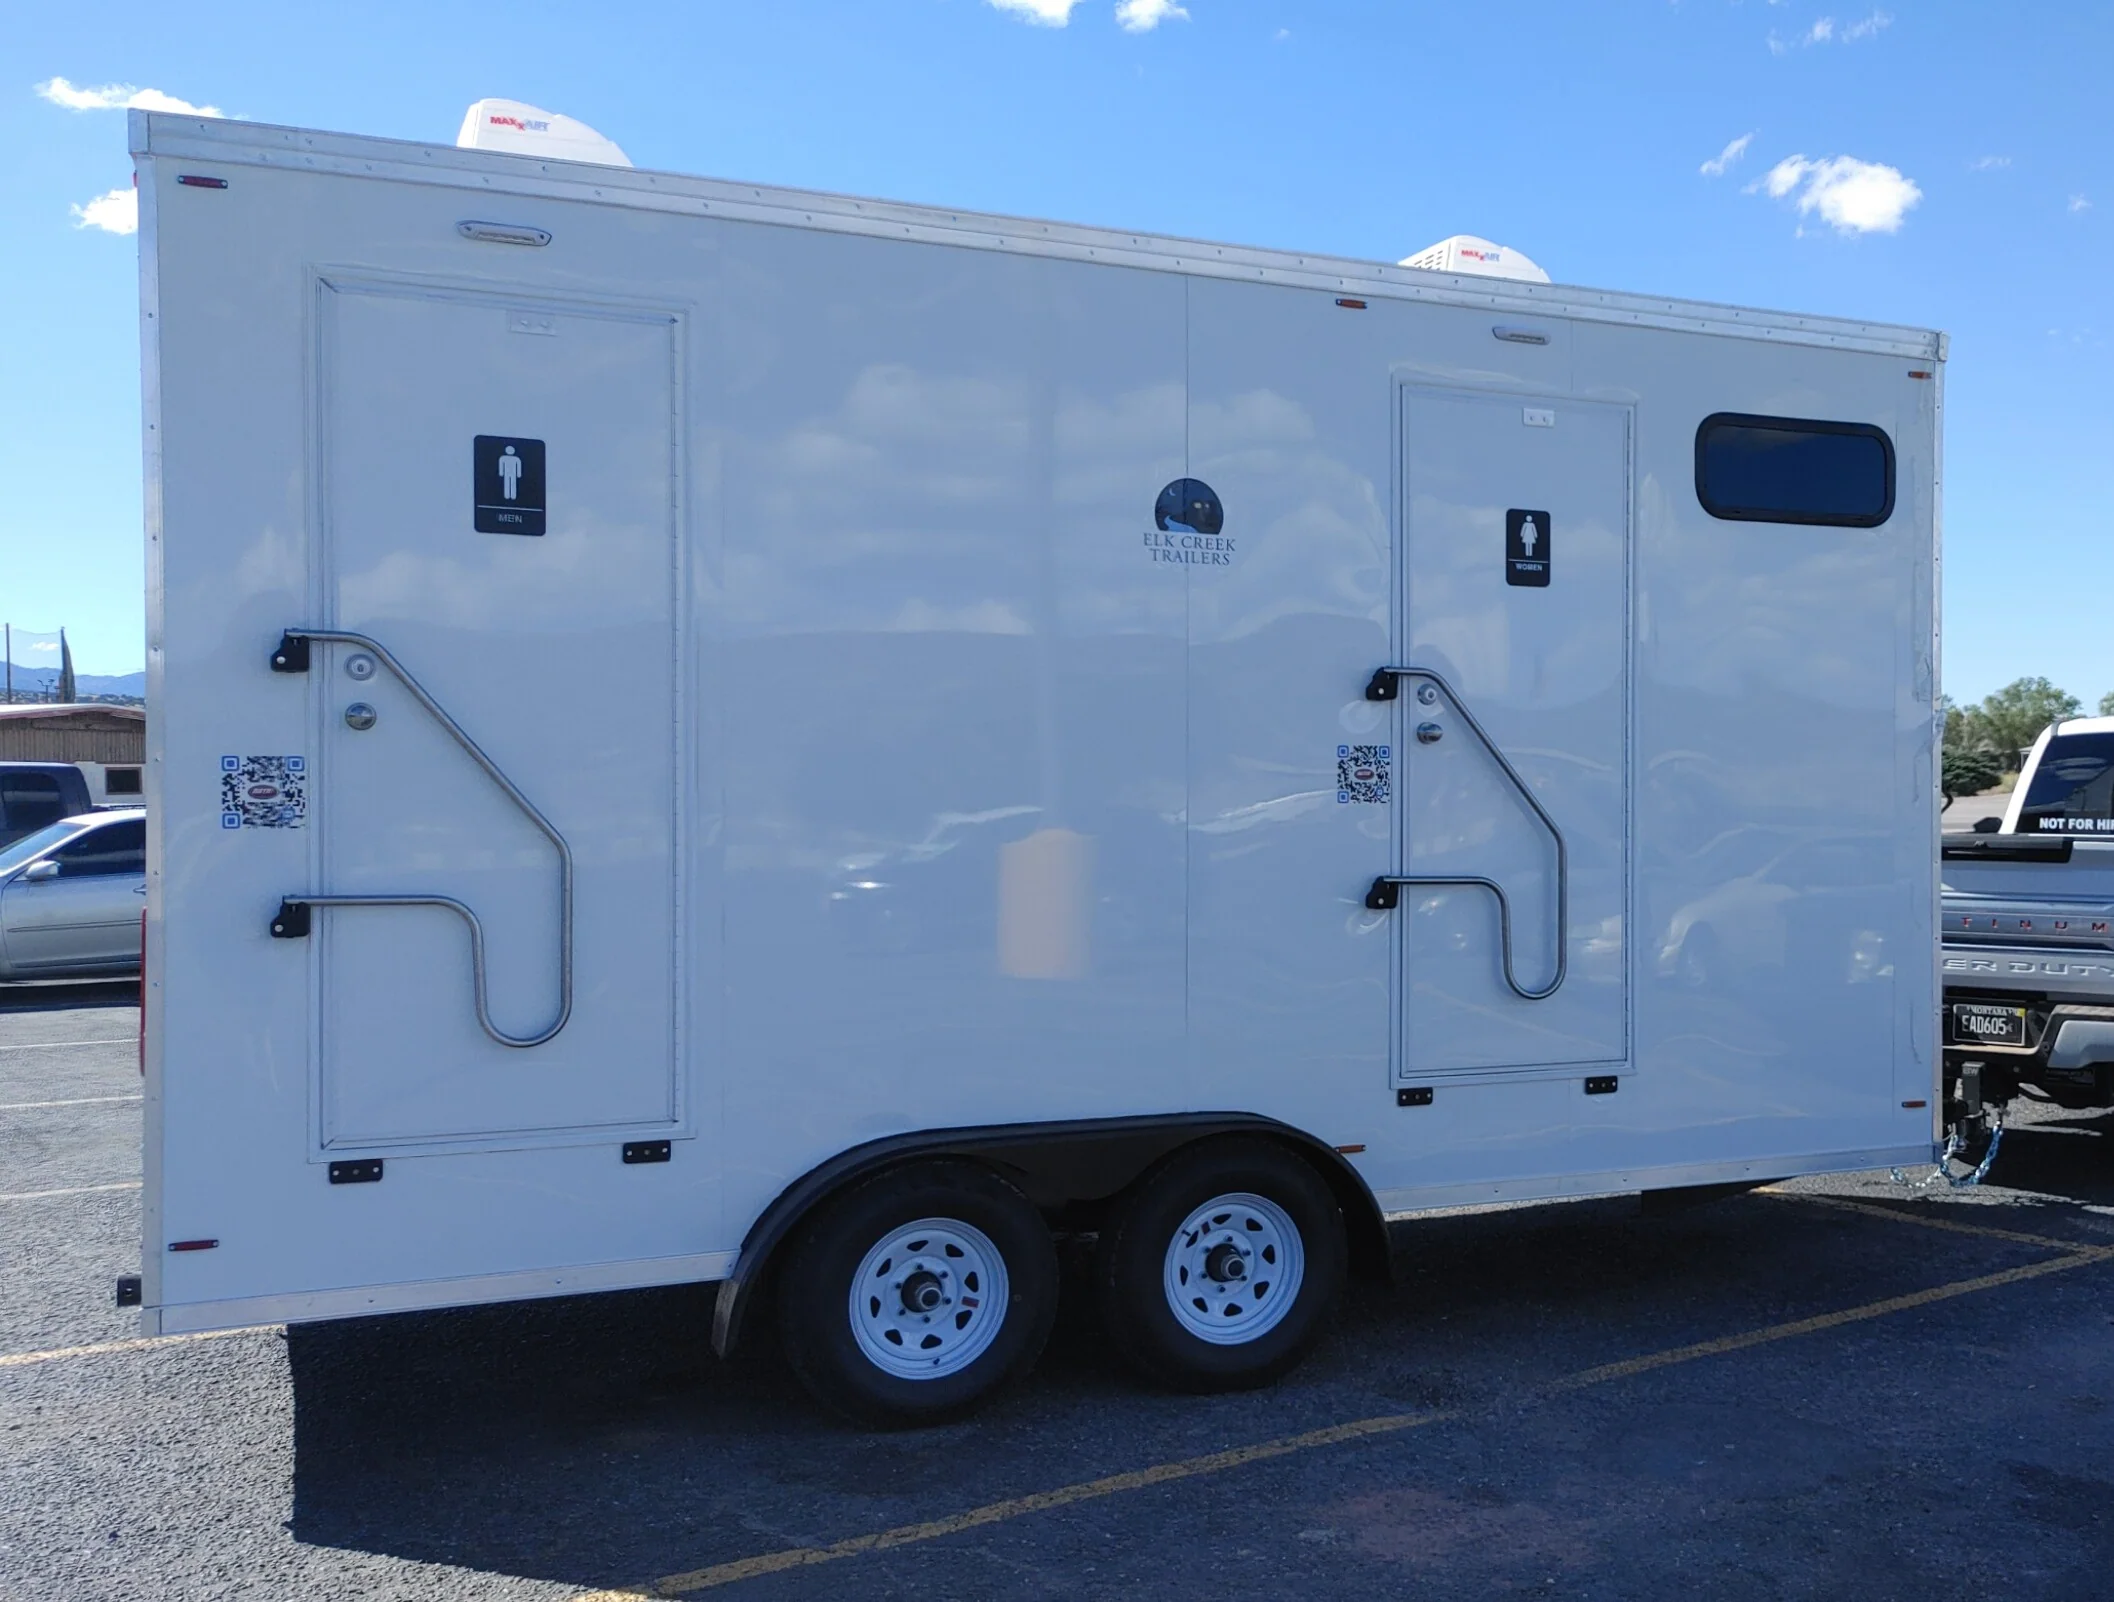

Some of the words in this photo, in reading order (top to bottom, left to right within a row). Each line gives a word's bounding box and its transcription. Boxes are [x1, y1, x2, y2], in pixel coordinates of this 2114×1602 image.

[498, 513, 523, 524] MEN
[1143, 532, 1175, 548] ELK
[1181, 535, 1236, 552] CREEK
[1149, 549, 1230, 566] TRAILERS
[1516, 562, 1543, 572] WOMEN
[2039, 817, 2066, 830] NOT
[2068, 818, 2094, 830] FOR
